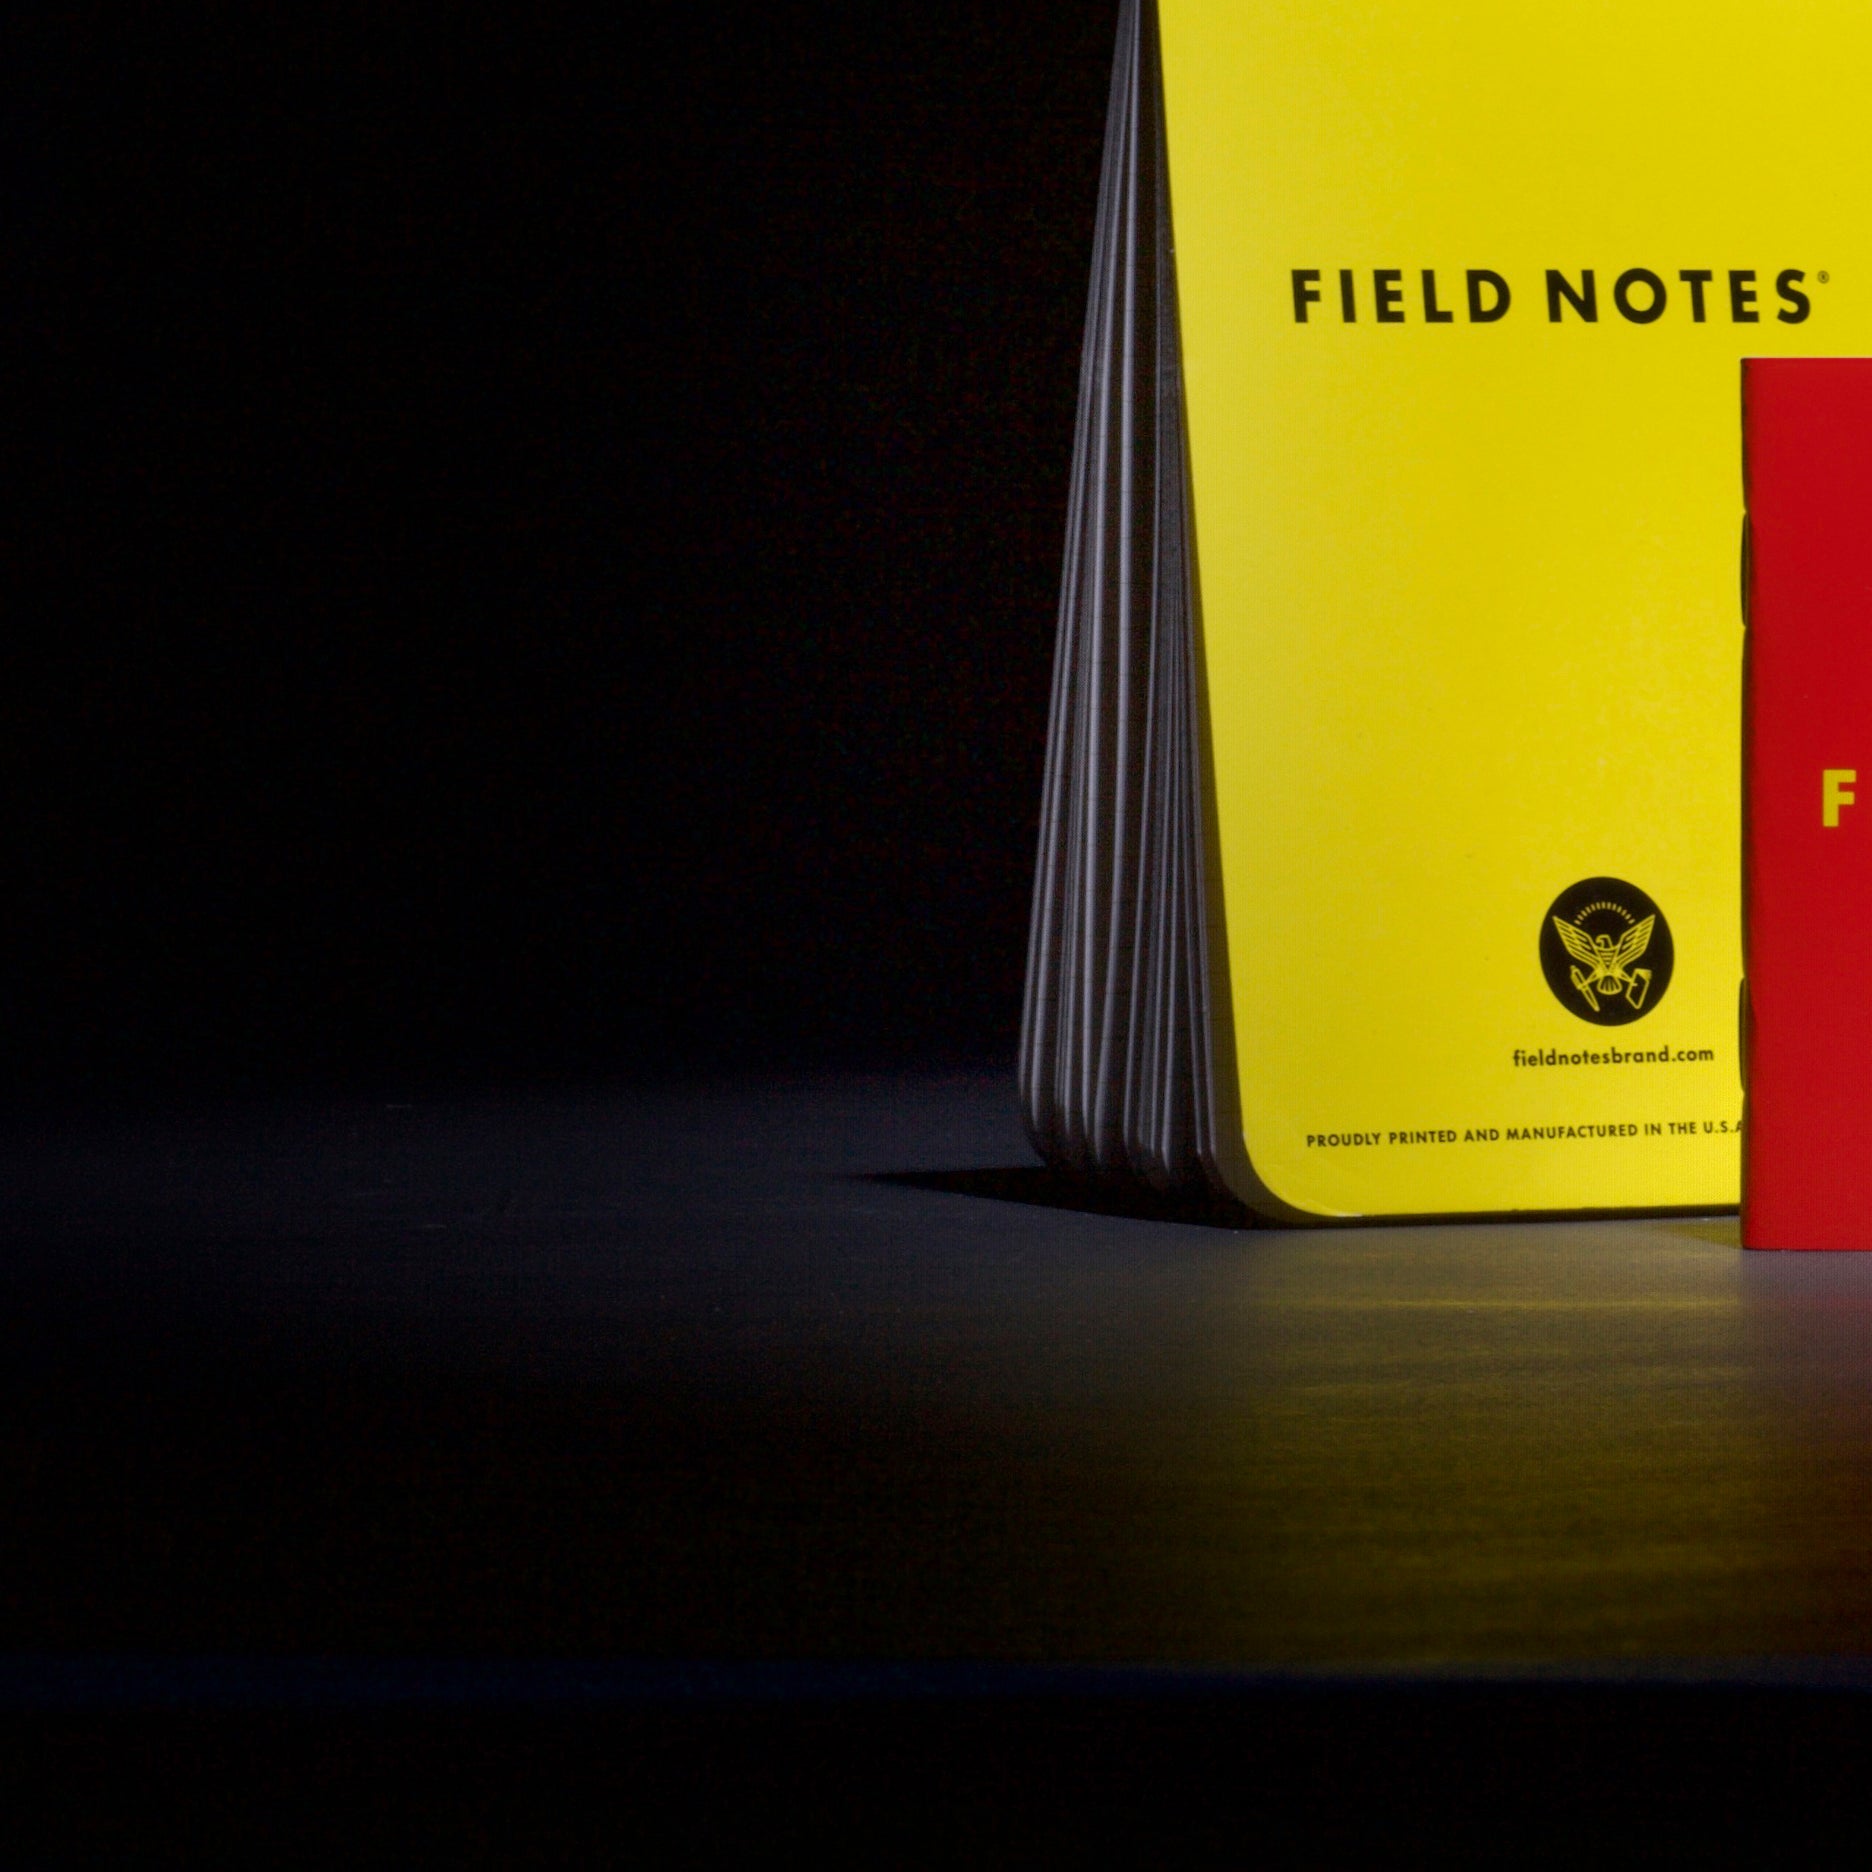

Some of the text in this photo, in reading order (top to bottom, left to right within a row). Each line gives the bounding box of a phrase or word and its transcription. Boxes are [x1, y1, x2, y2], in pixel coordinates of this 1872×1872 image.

[1291, 268, 1511, 324] FIELD
[1513, 1045, 1715, 1068] fieldnotesbrand.com
[1307, 1132, 1381, 1148] PROUDLY
[1389, 1129, 1457, 1145] PRINTED
[1464, 1127, 1501, 1142] AND
[1507, 1123, 1638, 1141] MANUFACTURED
[1644, 1123, 1662, 1136] IN
[1668, 1121, 1697, 1135] THE
